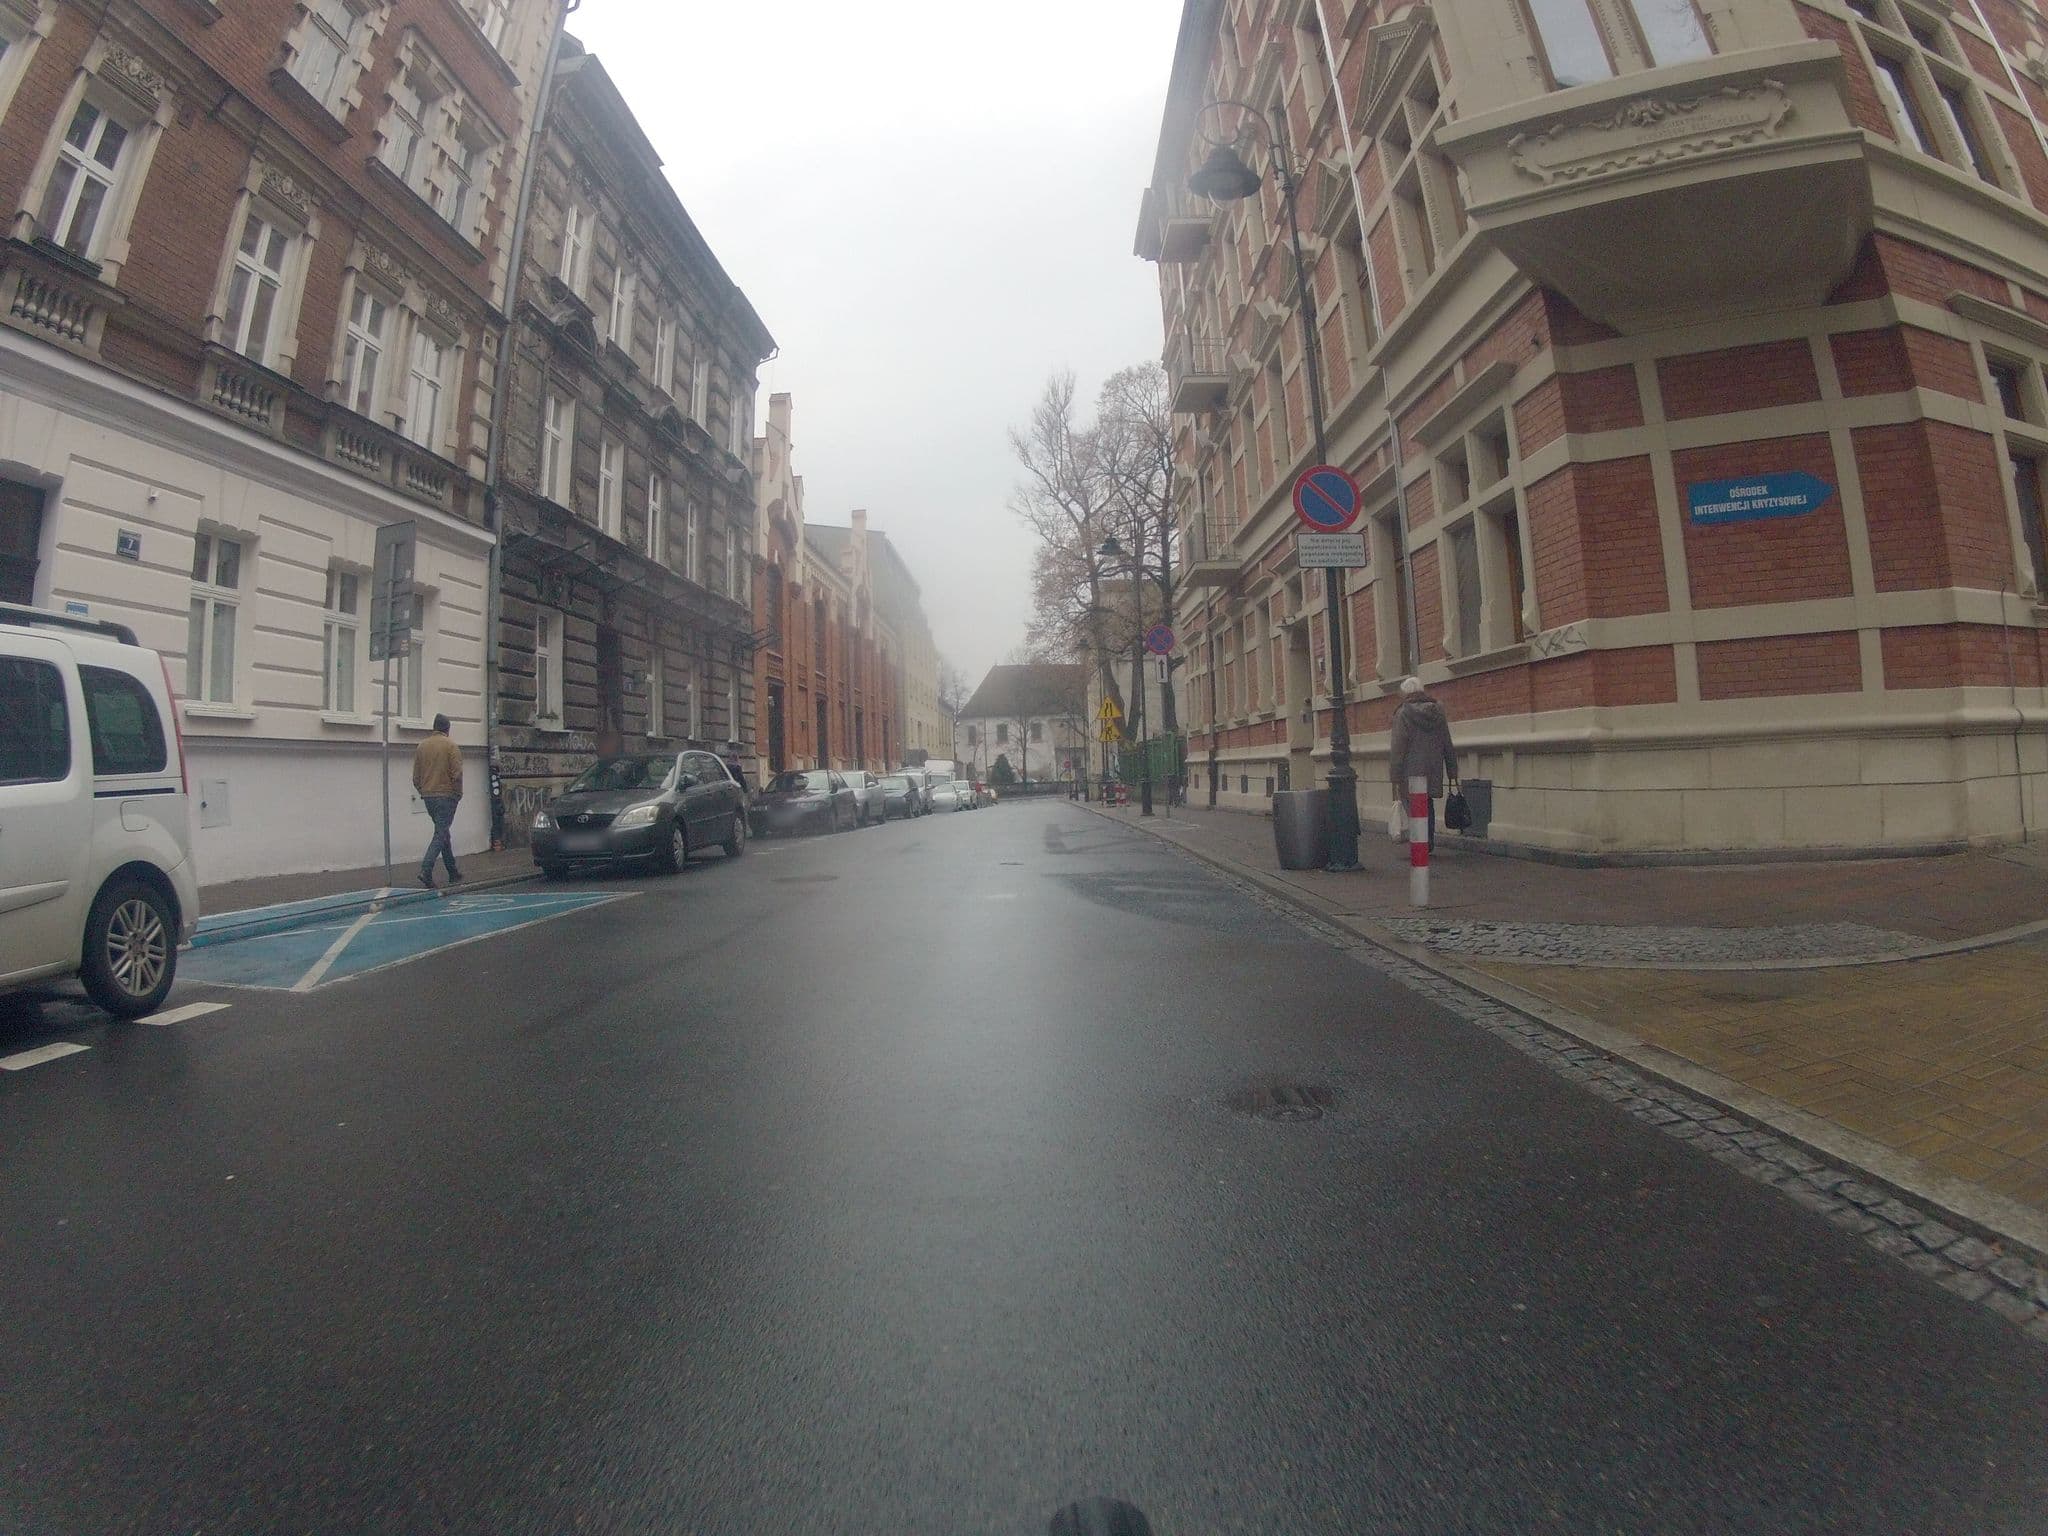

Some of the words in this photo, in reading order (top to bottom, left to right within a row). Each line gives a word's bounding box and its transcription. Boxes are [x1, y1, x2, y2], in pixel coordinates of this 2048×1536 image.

[1729, 484, 1768, 498] OŚRODEK
[1694, 500, 1750, 515] INTERWENCJI
[1752, 495, 1807, 509] KRYZYSOWEJ
[128, 538, 134, 550] 7
